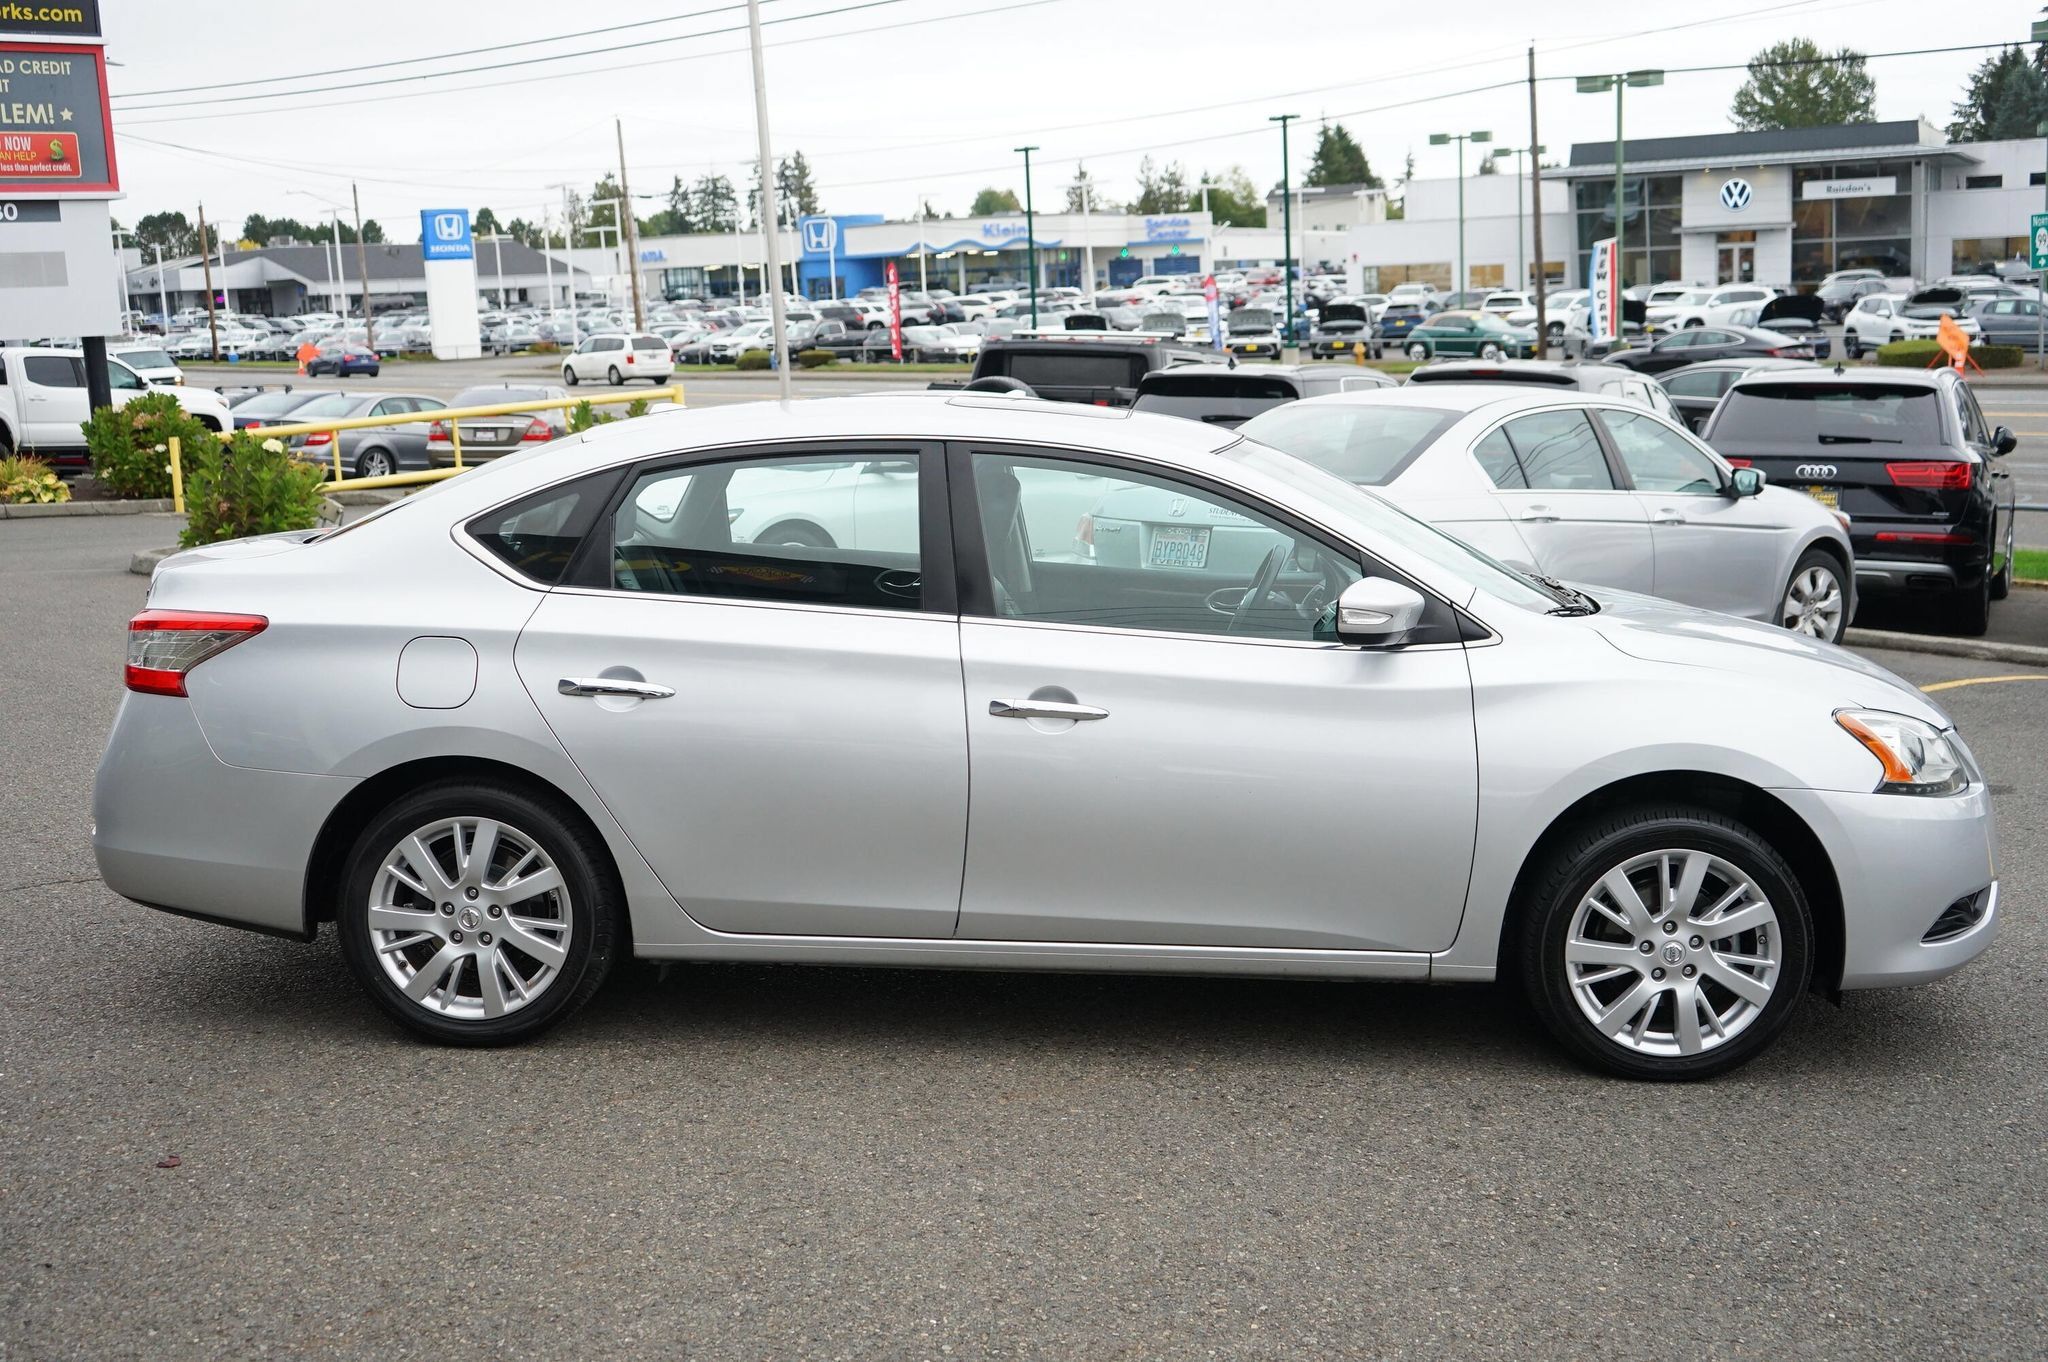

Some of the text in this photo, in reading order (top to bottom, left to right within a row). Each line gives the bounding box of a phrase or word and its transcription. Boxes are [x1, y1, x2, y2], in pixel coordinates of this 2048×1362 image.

[0, 2, 83, 22] rks.com
[20, 60, 71, 75] CREDIT
[4, 136, 31, 151] NOW
[13, 151, 37, 161] HELP
[1, 164, 13, 172] less
[15, 163, 29, 172] than
[30, 164, 52, 174] perfect
[982, 222, 1028, 237] Klein
[2037, 232, 2047, 247] 99
[430, 244, 471, 253] HONDA
[1597, 246, 1608, 280] NEW
[1154, 540, 1205, 561] BYP8048
[1151, 557, 1204, 568] EVERETT
